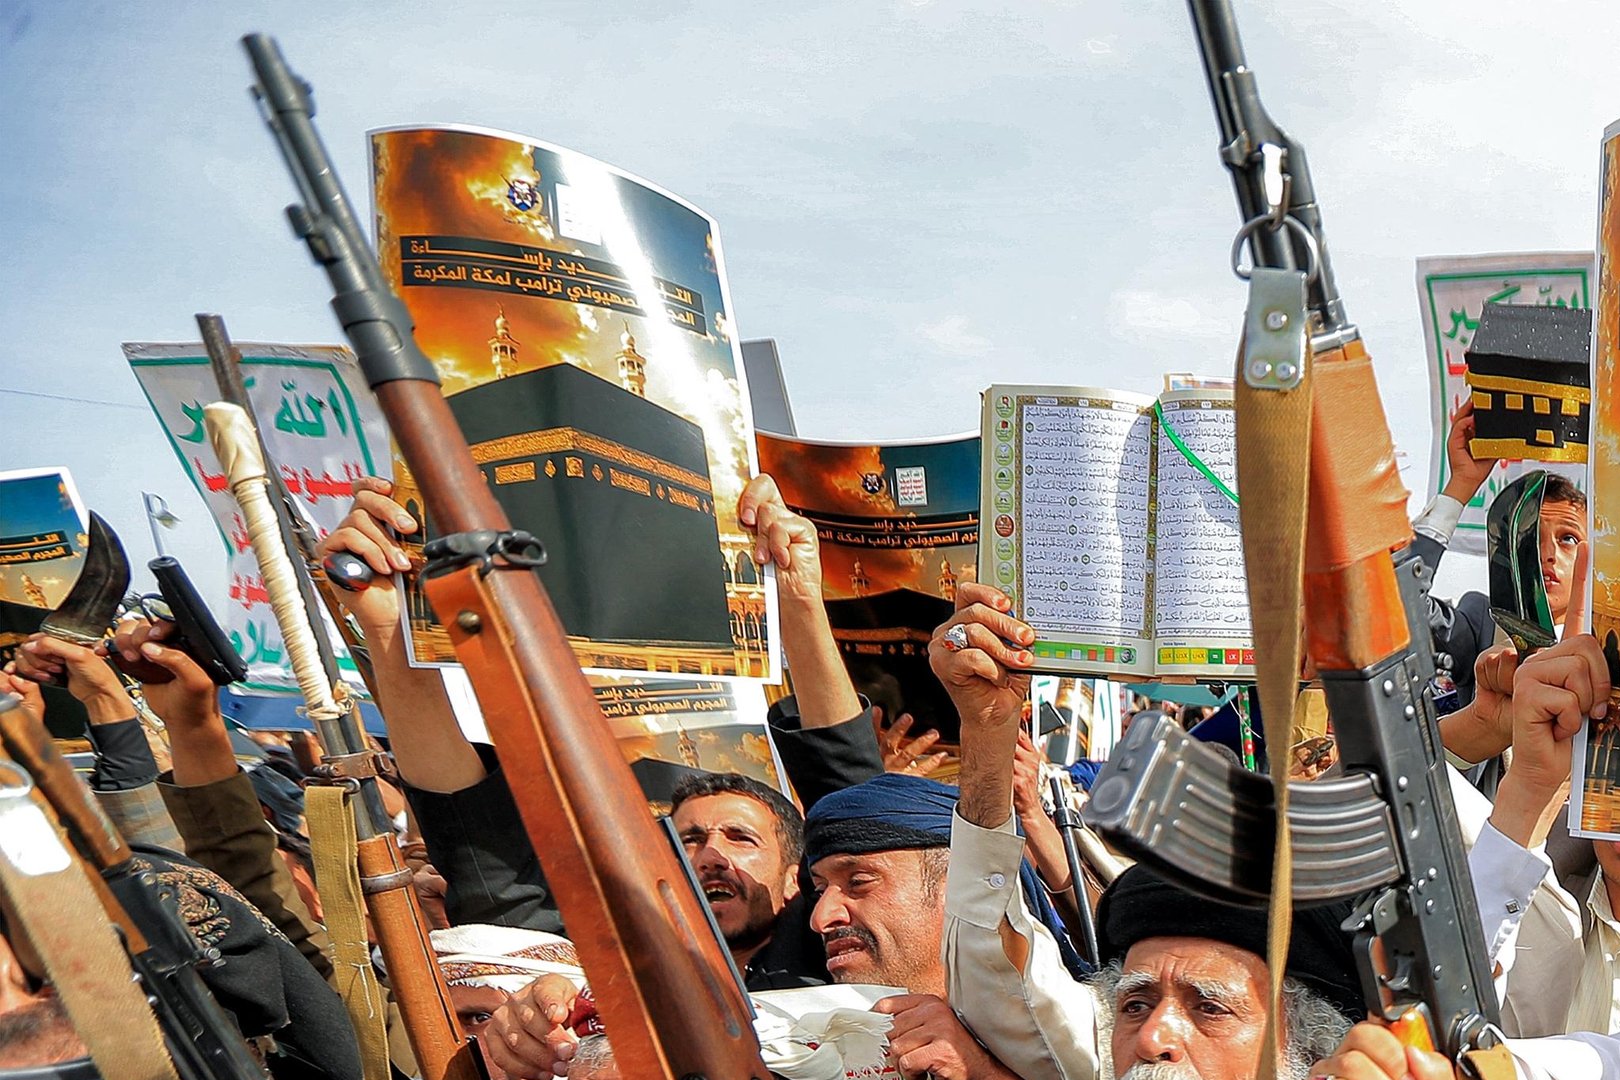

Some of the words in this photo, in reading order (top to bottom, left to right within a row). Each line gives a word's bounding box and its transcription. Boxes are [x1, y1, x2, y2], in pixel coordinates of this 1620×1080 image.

[413, 263, 468, 284] المكرمة
[472, 266, 512, 287] لمكة
[515, 277, 563, 296] ترامب
[568, 285, 641, 307] صهيوني
[274, 377, 349, 438] الله
[837, 532, 865, 545] لمكة
[868, 535, 901, 546] ترامب
[903, 531, 959, 548] الصهيوني
[634, 698, 691, 716] الصهيوني
[692, 696, 728, 712] المجرم
